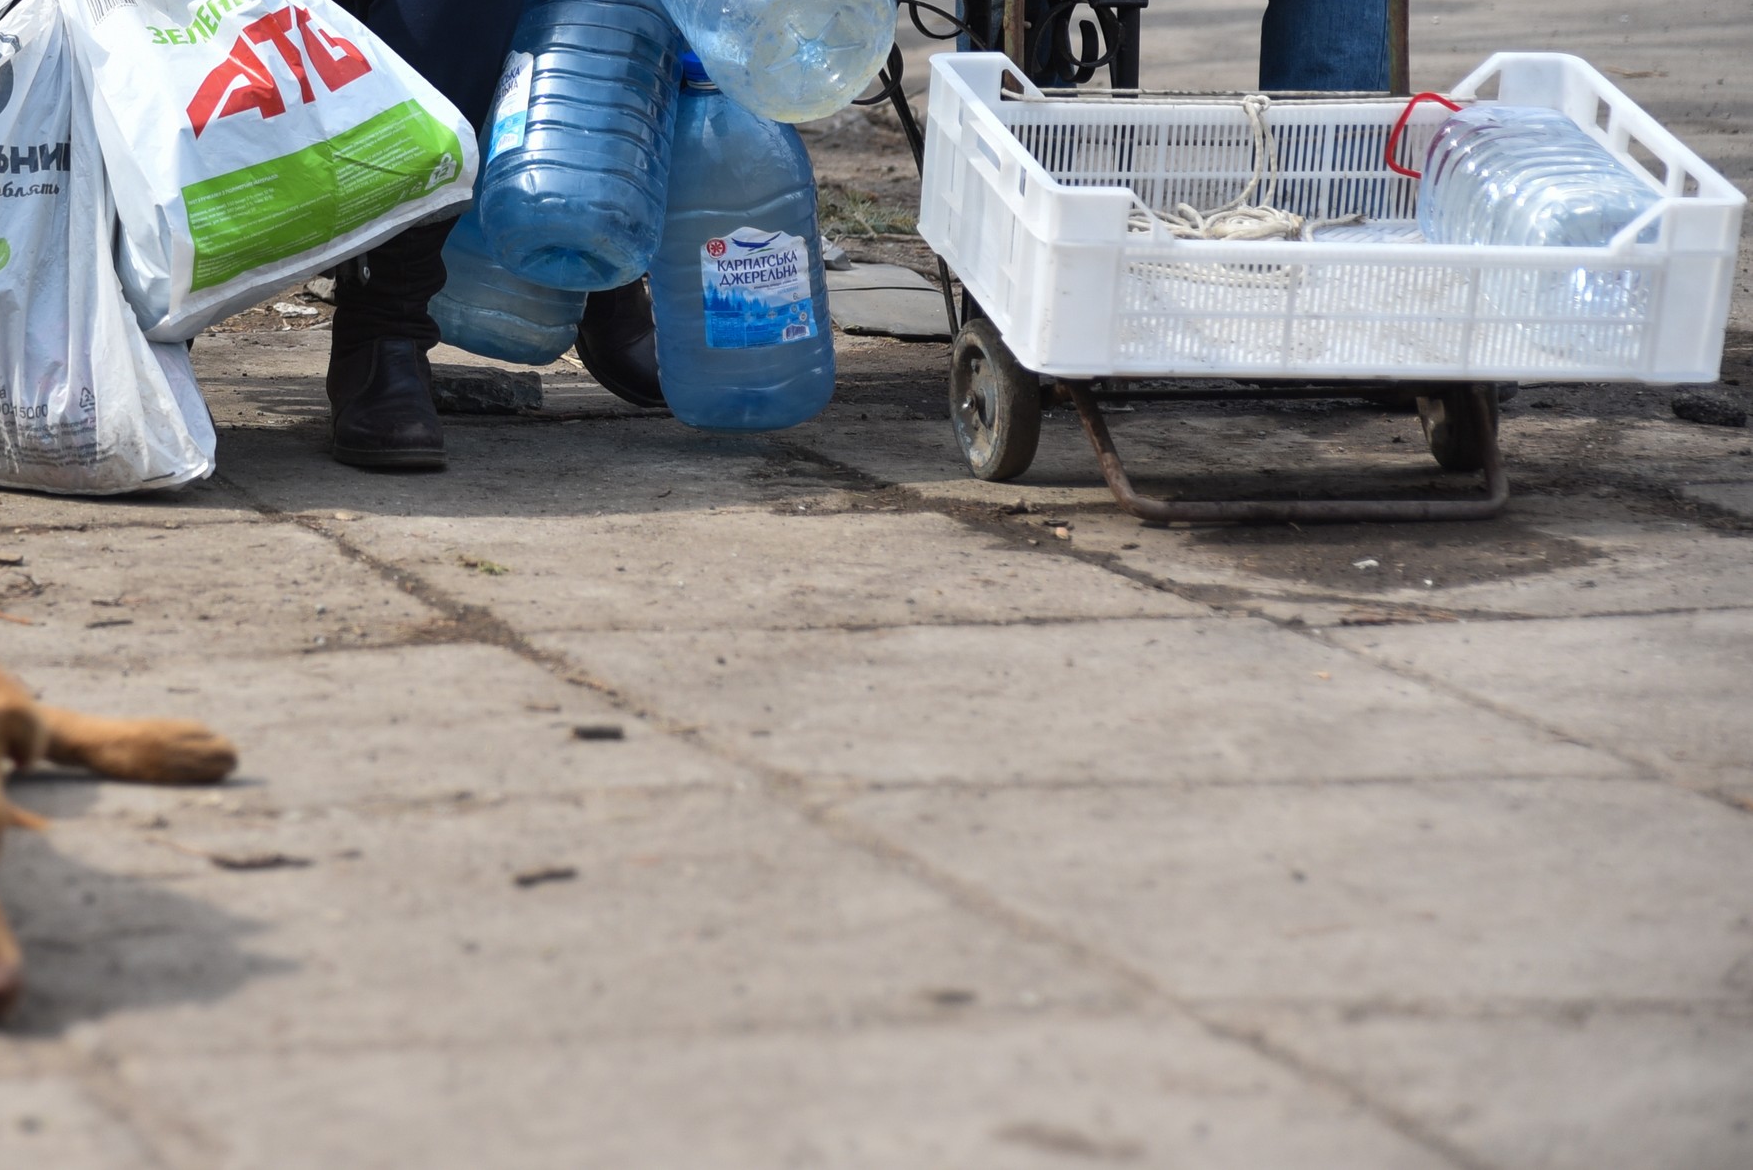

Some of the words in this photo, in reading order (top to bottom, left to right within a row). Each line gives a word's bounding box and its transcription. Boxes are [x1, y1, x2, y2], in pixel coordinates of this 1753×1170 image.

[186, 5, 373, 140] АТБ
[717, 250, 799, 272] КАРПАТСЬКА
[719, 264, 798, 287] ДЖЕРЕЛЬНА
